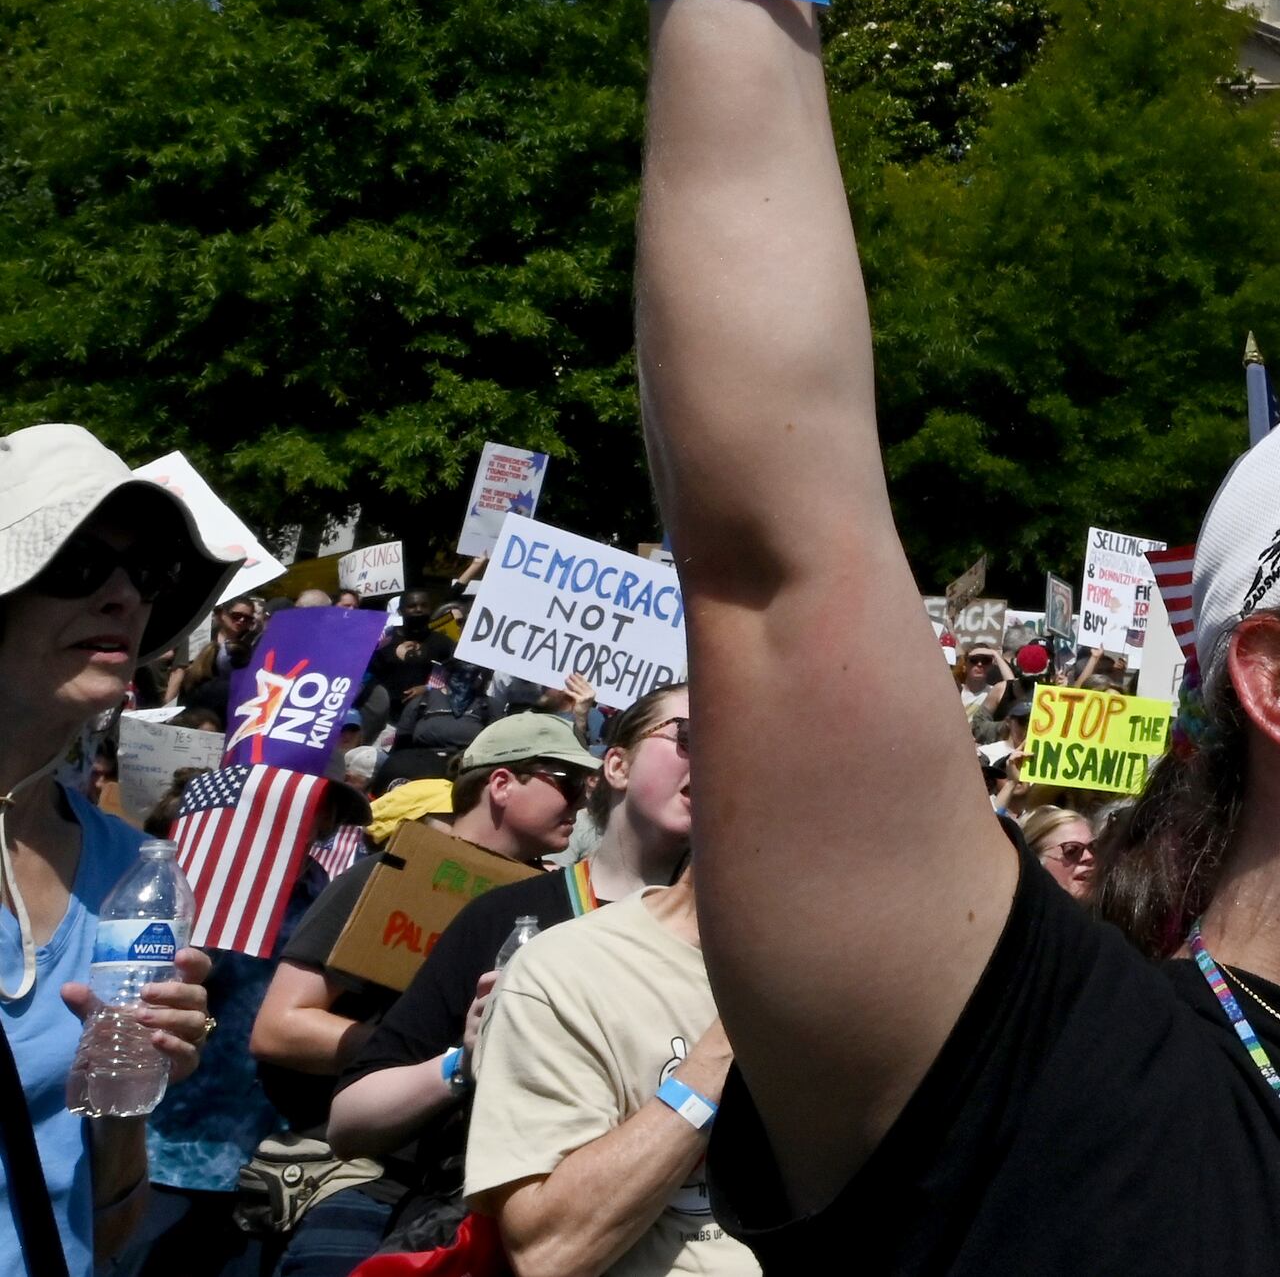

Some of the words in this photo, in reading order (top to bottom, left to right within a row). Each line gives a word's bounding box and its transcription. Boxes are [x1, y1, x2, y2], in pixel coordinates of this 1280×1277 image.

[362, 543, 401, 569] KINGS
[1093, 531, 1143, 557] SELLING
[501, 534, 685, 628] DEMOCRACY
[1087, 563, 1095, 578] &
[547, 595, 635, 643] NOT
[1083, 610, 1108, 636] BUY
[269, 673, 328, 743] NO
[306, 677, 351, 749] KINGS
[1032, 689, 1127, 744] STOP
[1128, 715, 1165, 742] THE
[134, 944, 174, 954] WATER
